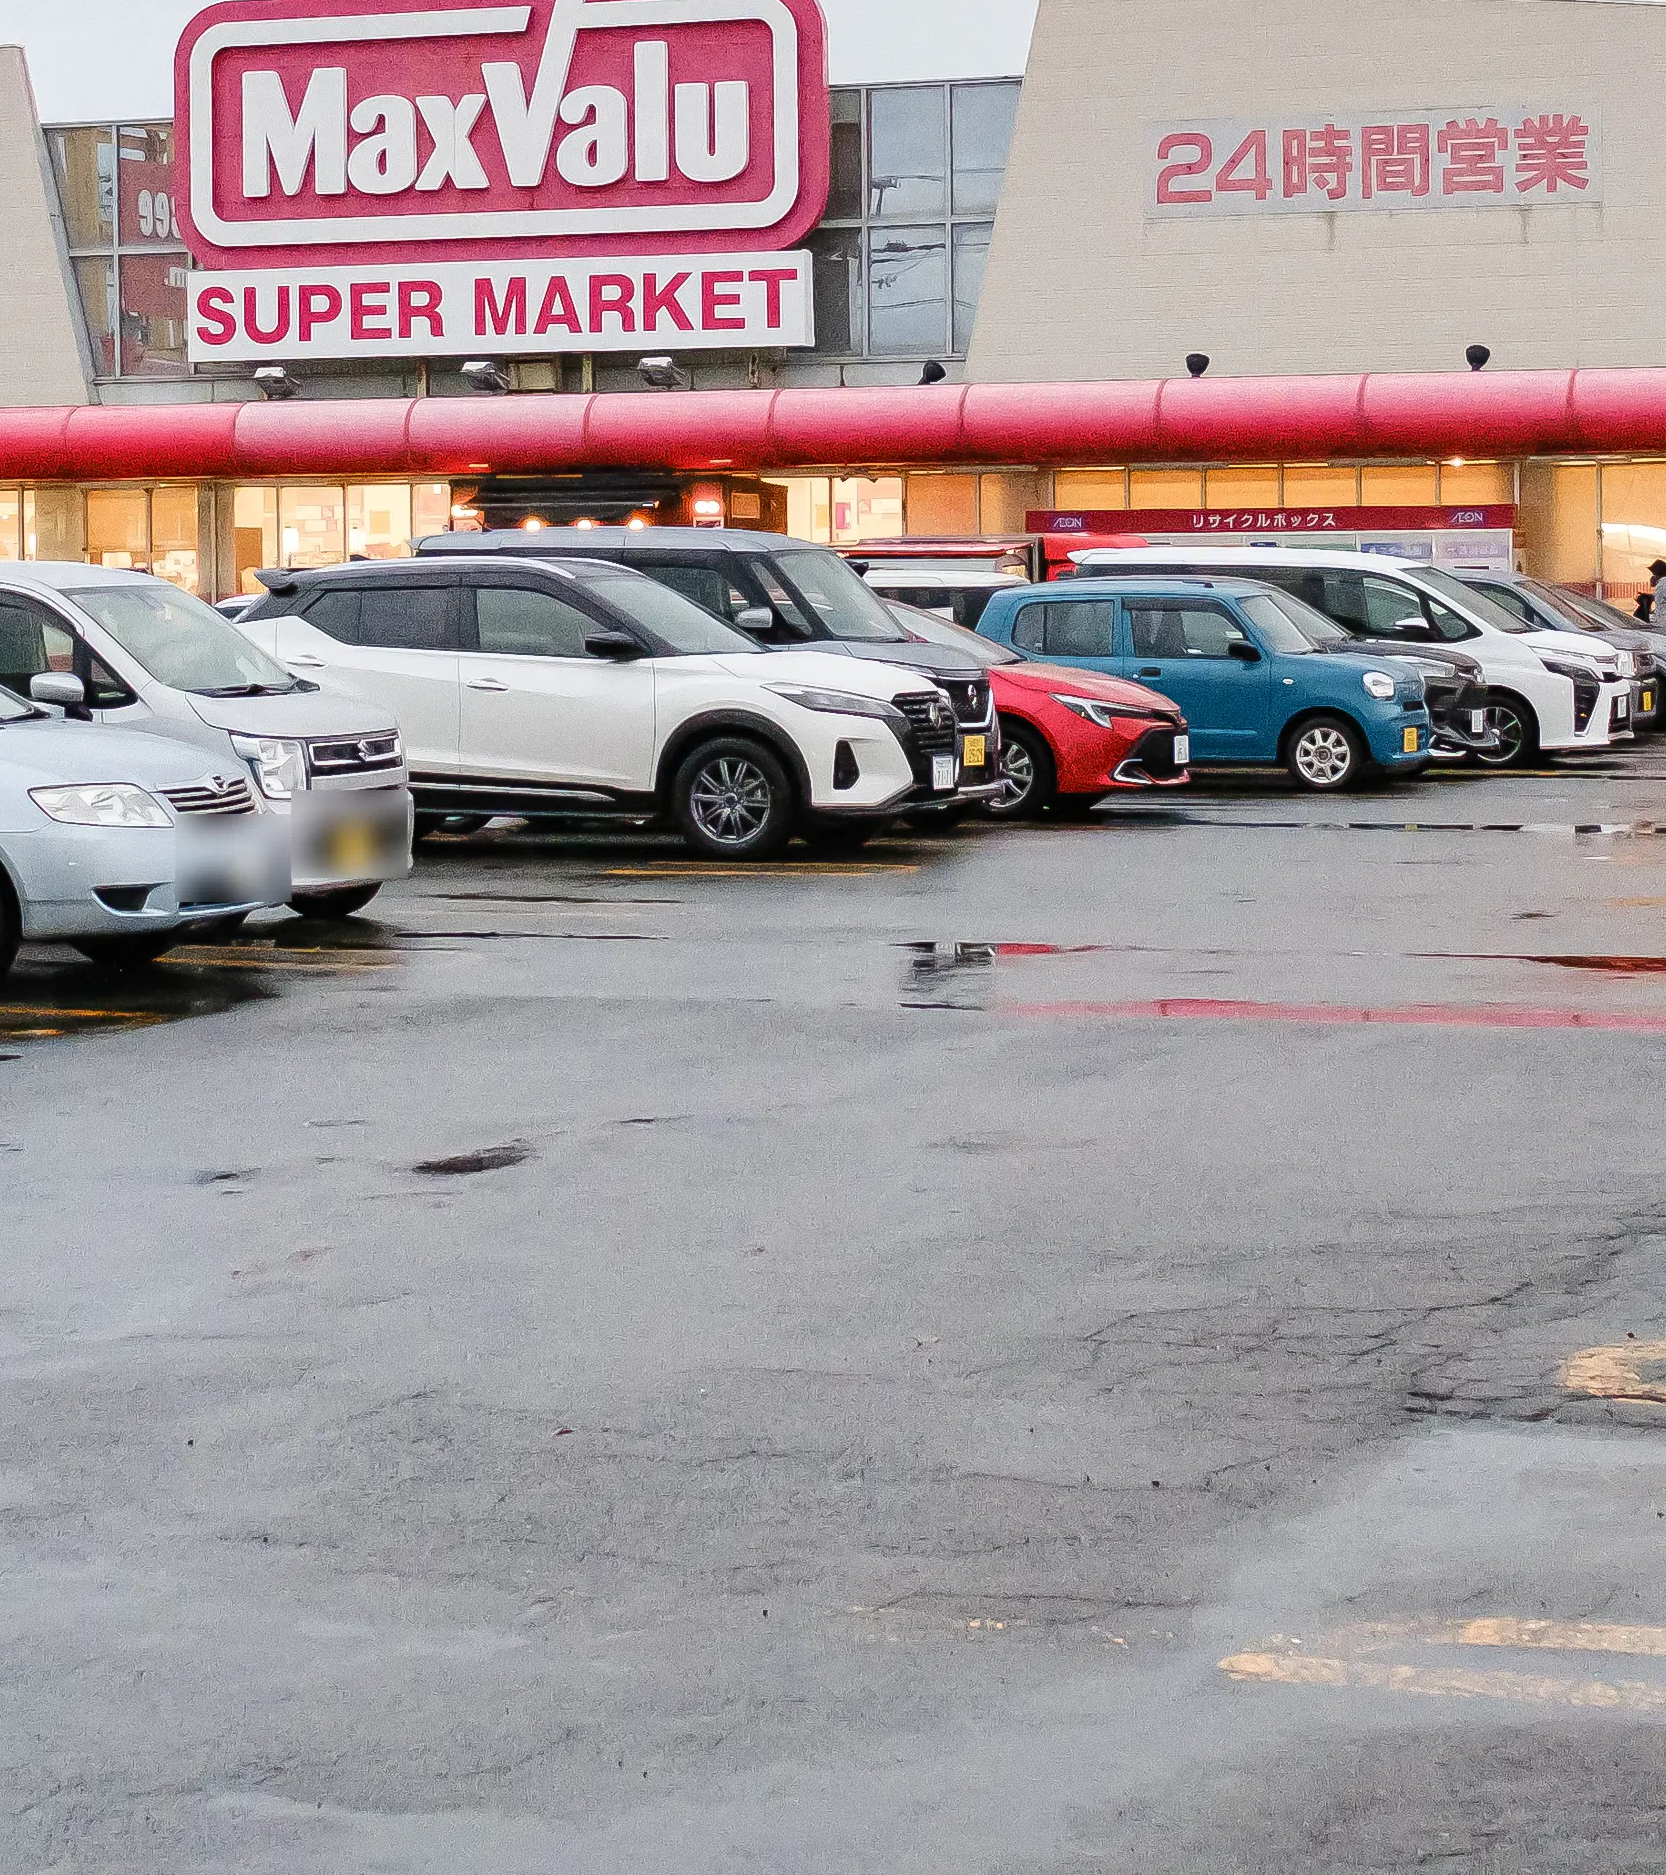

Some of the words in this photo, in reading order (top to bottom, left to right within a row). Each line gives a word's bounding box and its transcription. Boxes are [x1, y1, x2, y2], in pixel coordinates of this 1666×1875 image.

[1156, 113, 1590, 205] 24時間営業
[196, 280, 445, 345] SUPER
[474, 267, 799, 337] MARKET
[1192, 511, 1336, 529] リサイクルボックス
